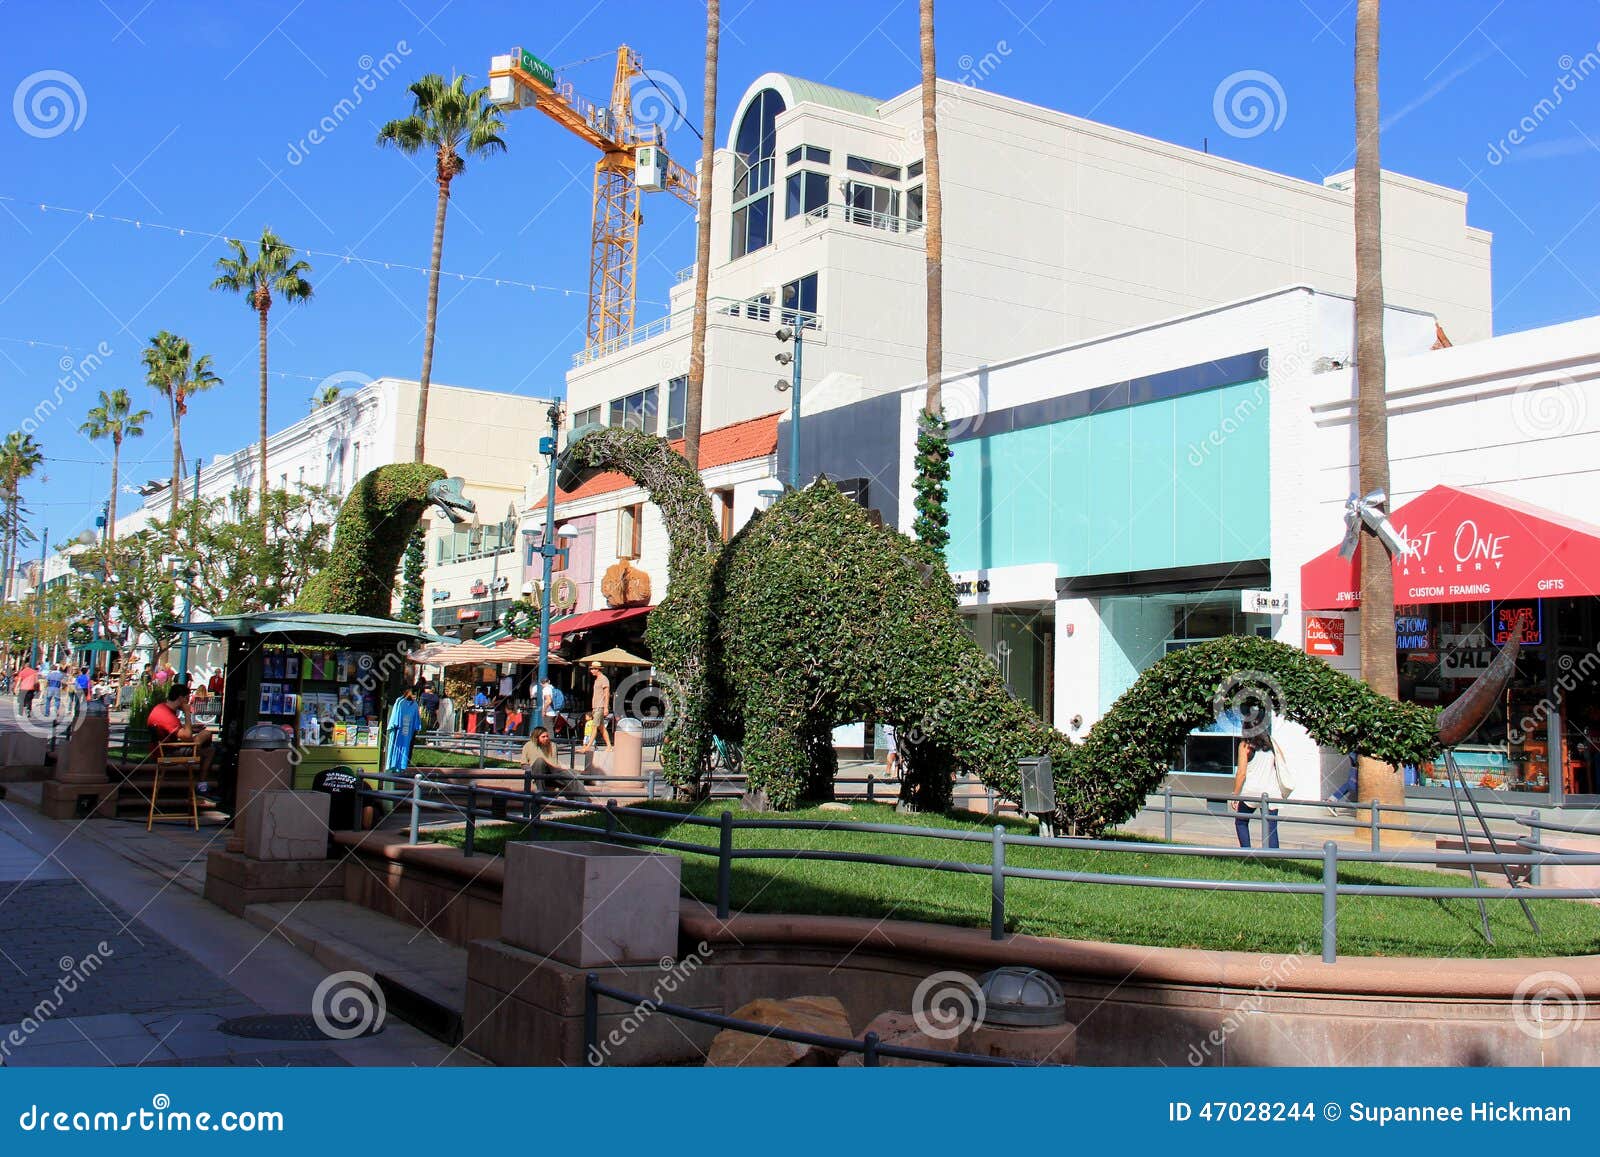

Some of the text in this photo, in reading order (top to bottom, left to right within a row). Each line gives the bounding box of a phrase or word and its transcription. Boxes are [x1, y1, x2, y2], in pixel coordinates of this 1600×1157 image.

[1403, 561, 1501, 576] ALLERY
[1408, 583, 1491, 598] CUSTOM FRAMING
[1537, 579, 1565, 591] GIFTS
[1335, 591, 1361, 601] JEWEL
[1499, 608, 1533, 620] SILVER
[1507, 619, 1536, 631] BDY
[1396, 635, 1430, 648] AMING
[1496, 631, 1539, 642] JELRY
